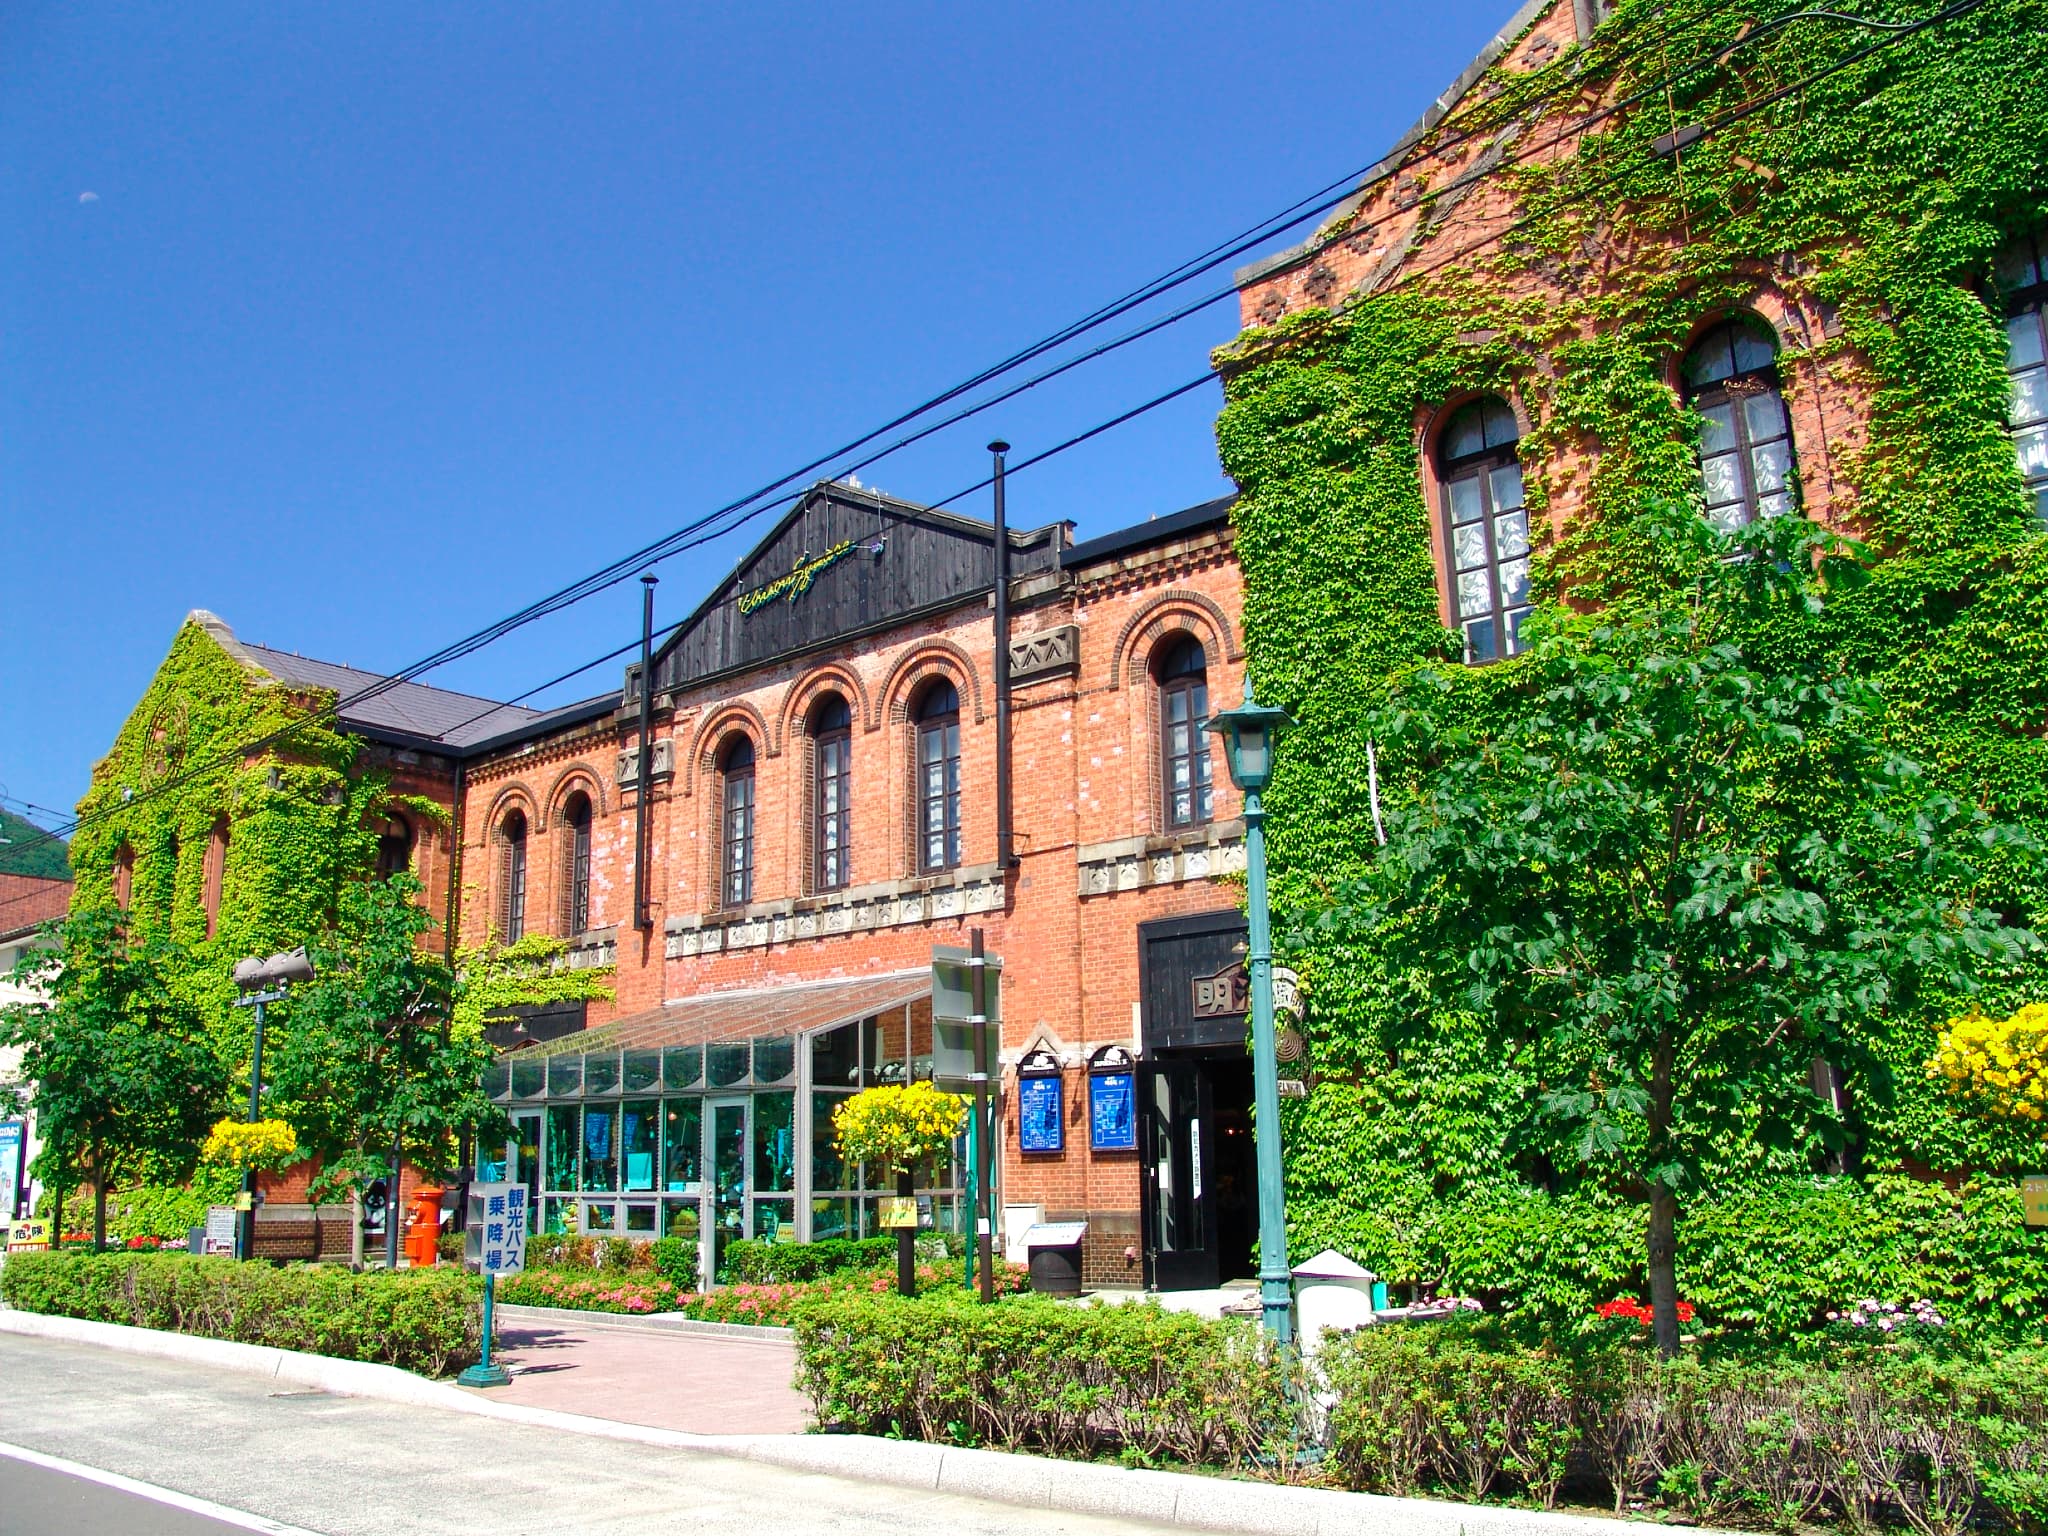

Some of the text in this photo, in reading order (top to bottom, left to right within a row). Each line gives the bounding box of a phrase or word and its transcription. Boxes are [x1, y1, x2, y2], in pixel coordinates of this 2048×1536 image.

[486, 1196, 505, 1271] 乗降場
[507, 1189, 524, 1267] 観光バス
